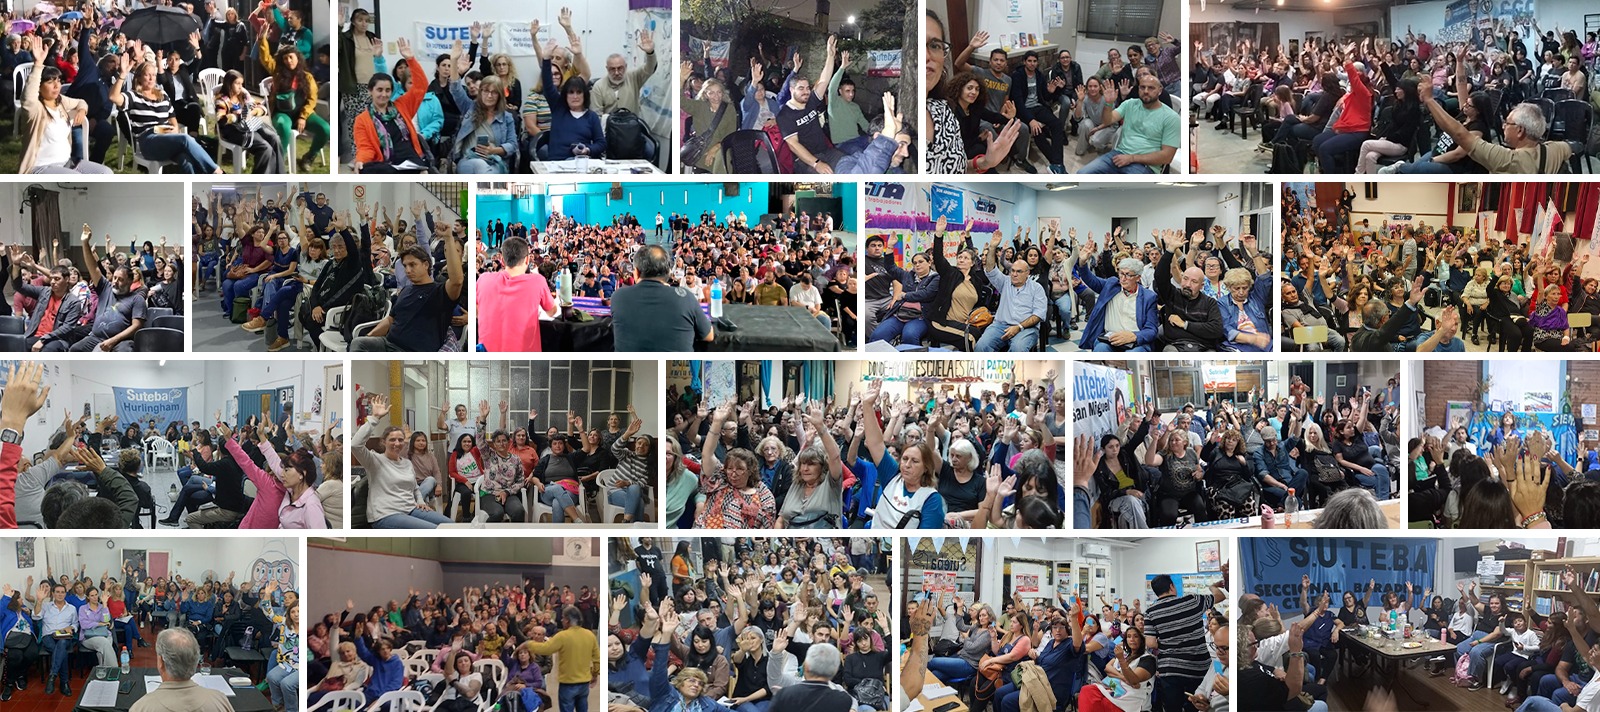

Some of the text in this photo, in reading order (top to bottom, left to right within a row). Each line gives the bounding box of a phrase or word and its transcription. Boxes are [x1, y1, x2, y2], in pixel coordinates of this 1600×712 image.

[425, 26, 492, 40] SUTE
[872, 52, 897, 61] Suteba
[796, 115, 809, 126] EAST
[916, 360, 954, 378] ESCUELA
[126, 389, 168, 402] Suteba
[123, 402, 180, 414] Hurlingham
[1088, 400, 1111, 417] Miguel
